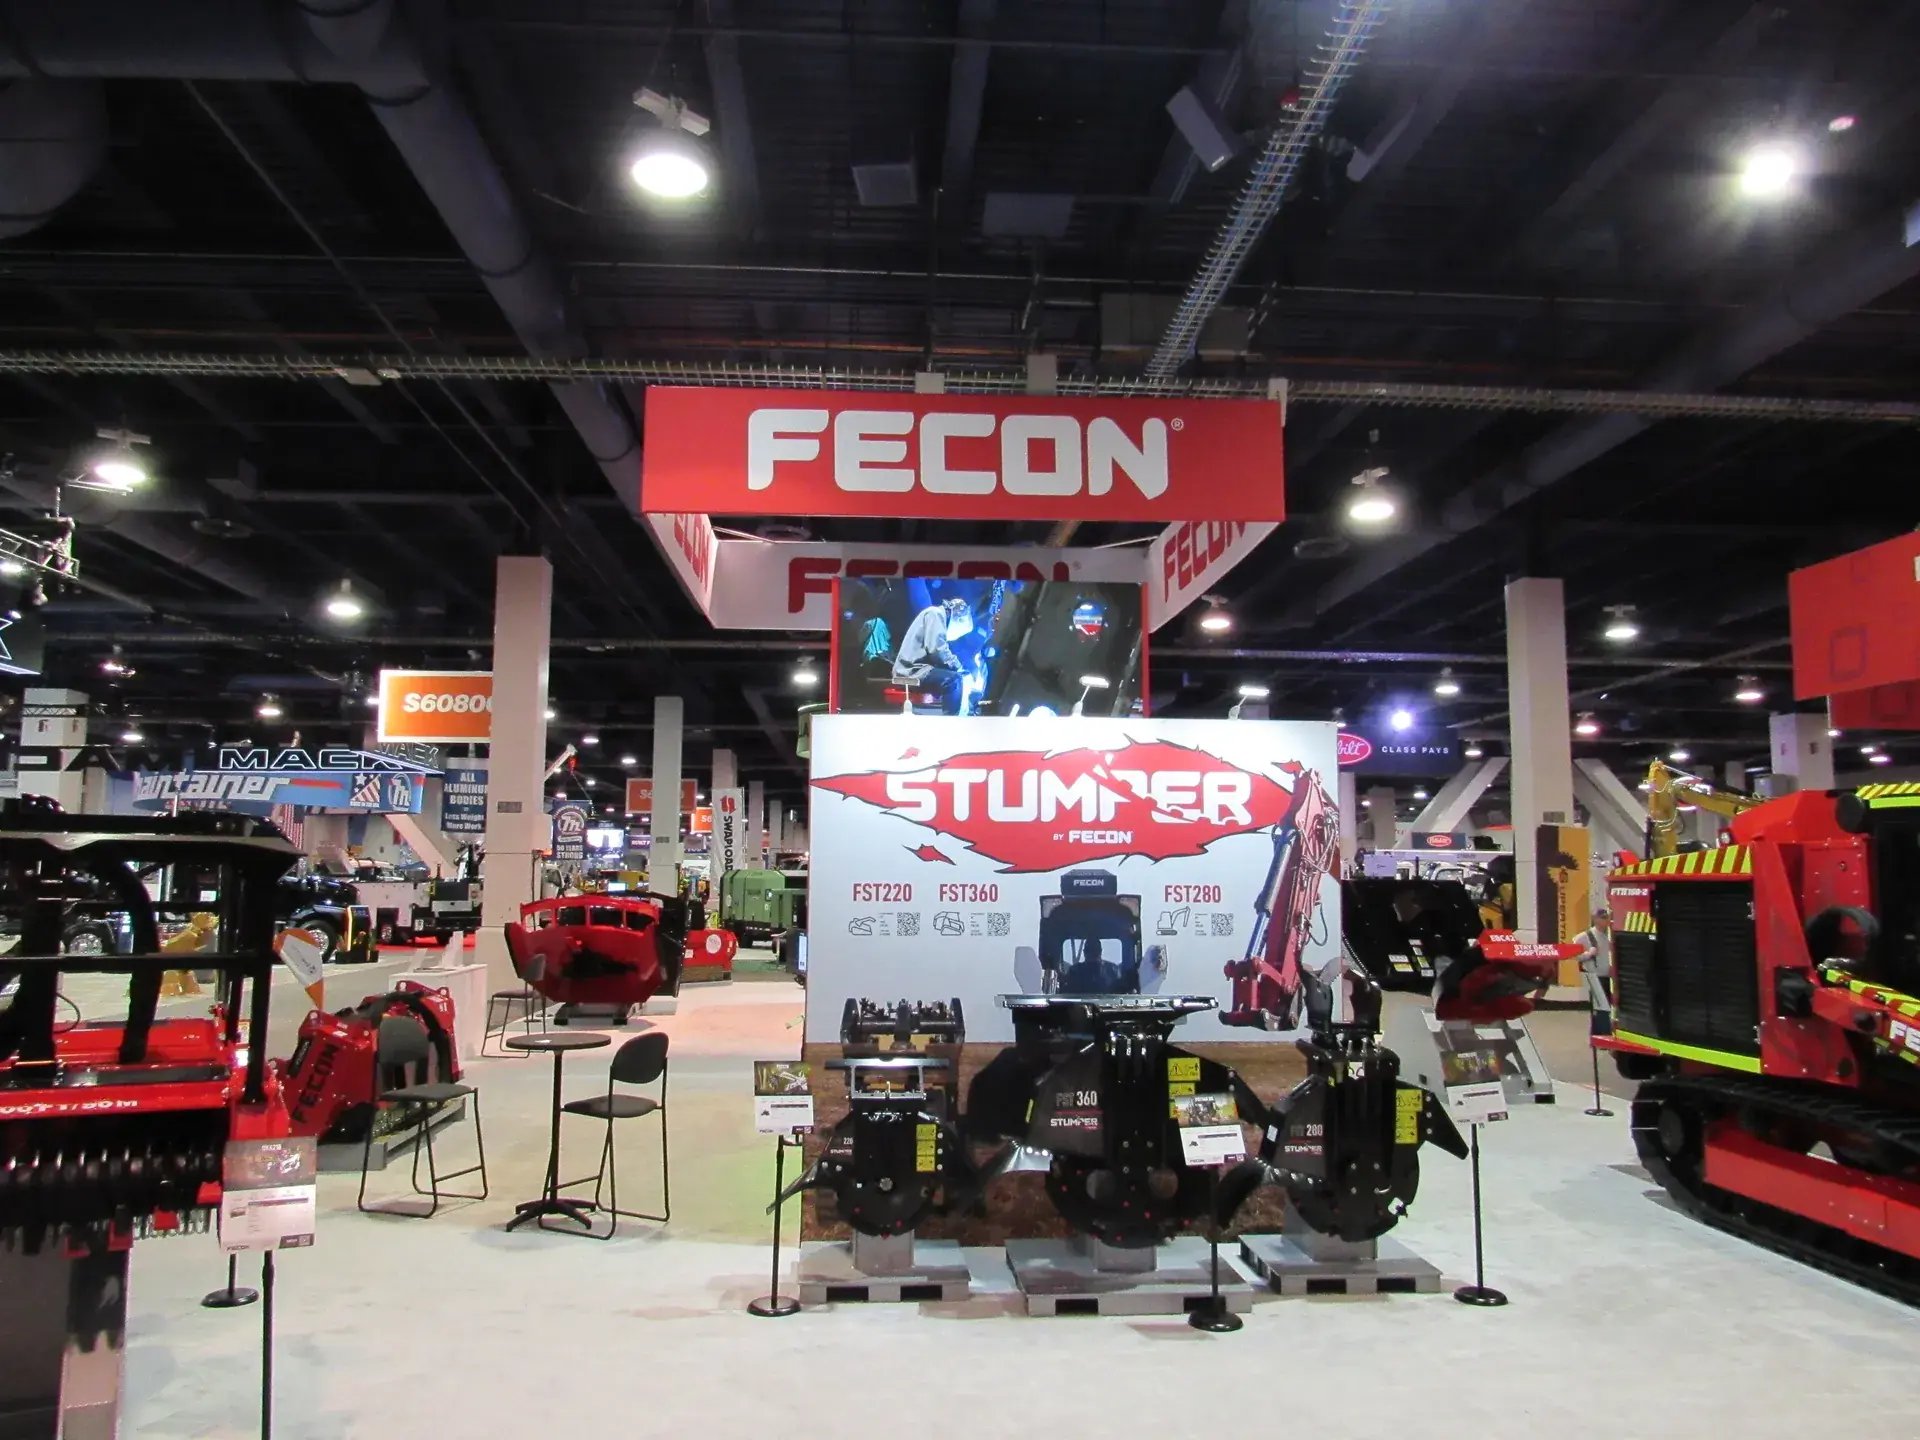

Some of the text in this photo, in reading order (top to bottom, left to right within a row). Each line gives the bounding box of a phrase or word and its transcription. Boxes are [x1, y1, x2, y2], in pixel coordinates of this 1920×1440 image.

[748, 409, 1168, 499] FECON
[220, 749, 402, 769] MACK
[460, 772, 476, 782] ALL
[449, 795, 484, 806] BODIES
[886, 768, 1251, 826] STUMPER
[1053, 830, 1131, 845] BY FECON
[1073, 879, 1105, 887] FECON
[853, 884, 1222, 903] FST220 FST360 FST280
[1076, 1090, 1097, 1106] 360
[1050, 1116, 1098, 1127] STUMPER
